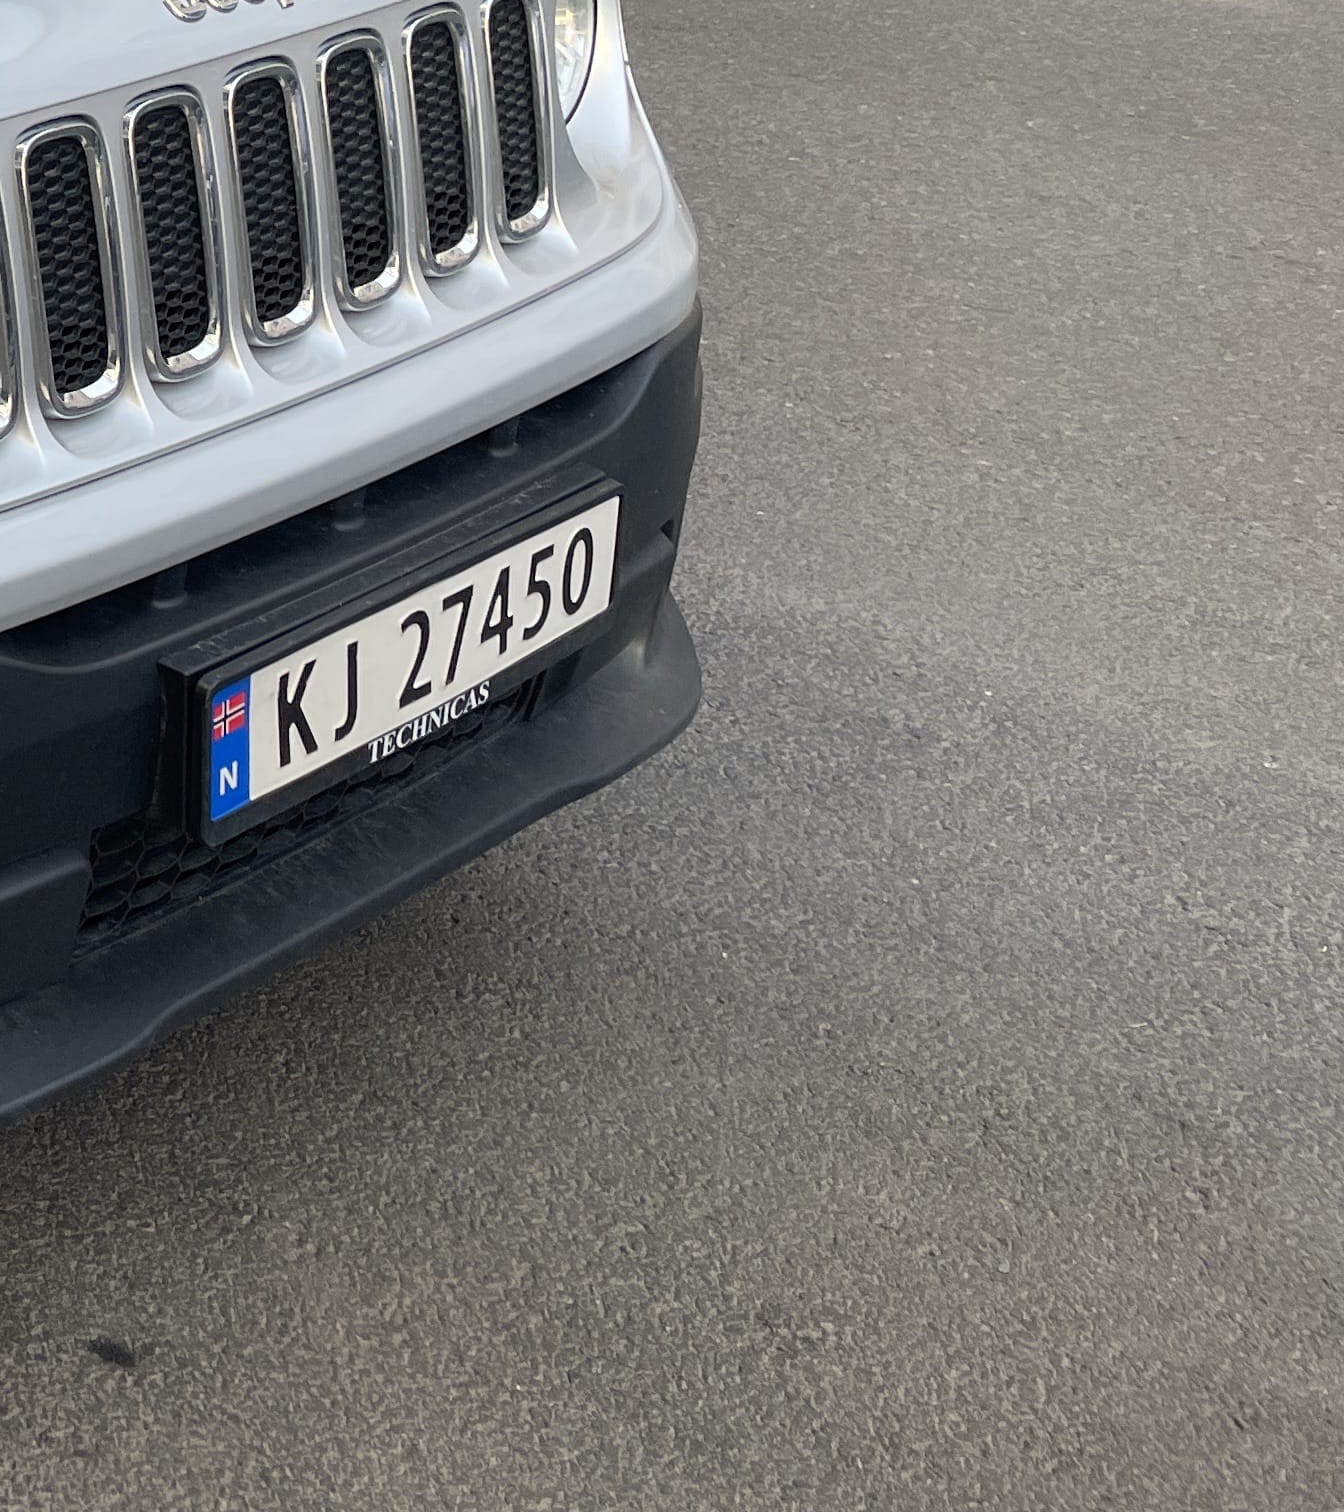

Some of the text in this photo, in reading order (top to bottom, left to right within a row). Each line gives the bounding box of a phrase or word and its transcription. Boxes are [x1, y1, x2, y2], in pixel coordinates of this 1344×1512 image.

[276, 527, 594, 768] KJ 27450
[219, 760, 239, 796] N
